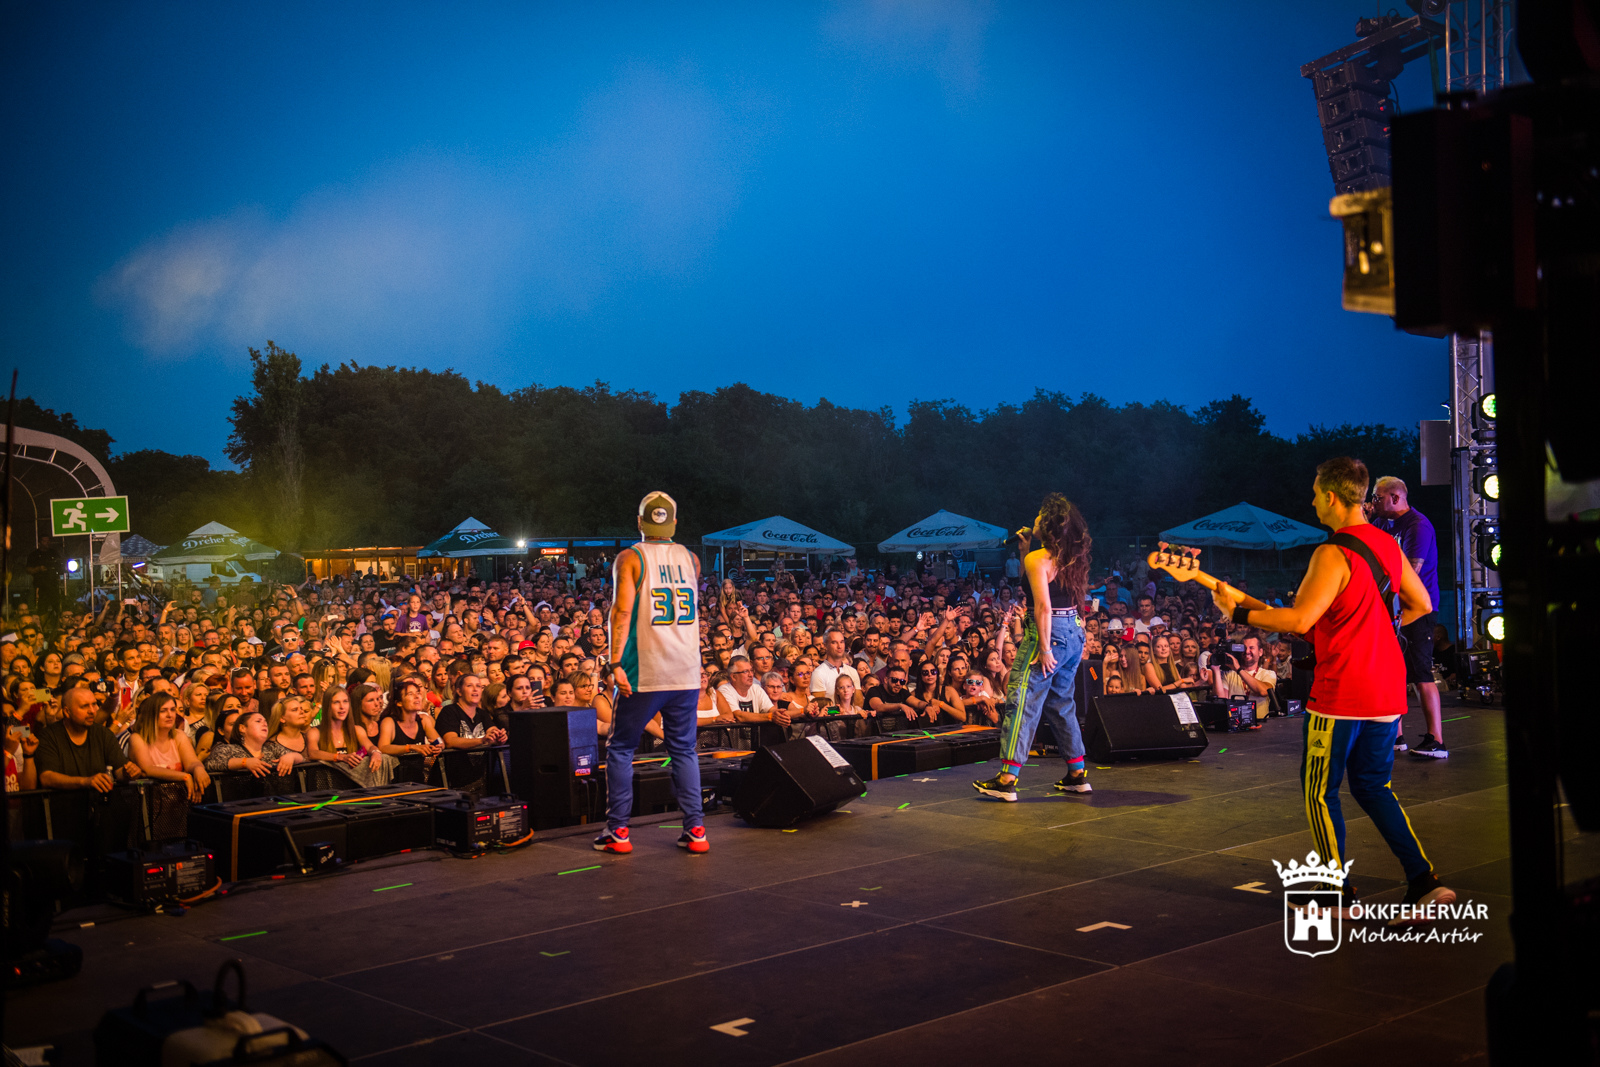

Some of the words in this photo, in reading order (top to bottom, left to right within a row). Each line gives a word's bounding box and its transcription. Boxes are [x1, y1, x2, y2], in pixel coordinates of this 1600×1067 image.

[182, 536, 225, 550] Dreher
[762, 529, 819, 543] Coca-Cola
[658, 564, 686, 584] HILL
[651, 587, 696, 626] 33
